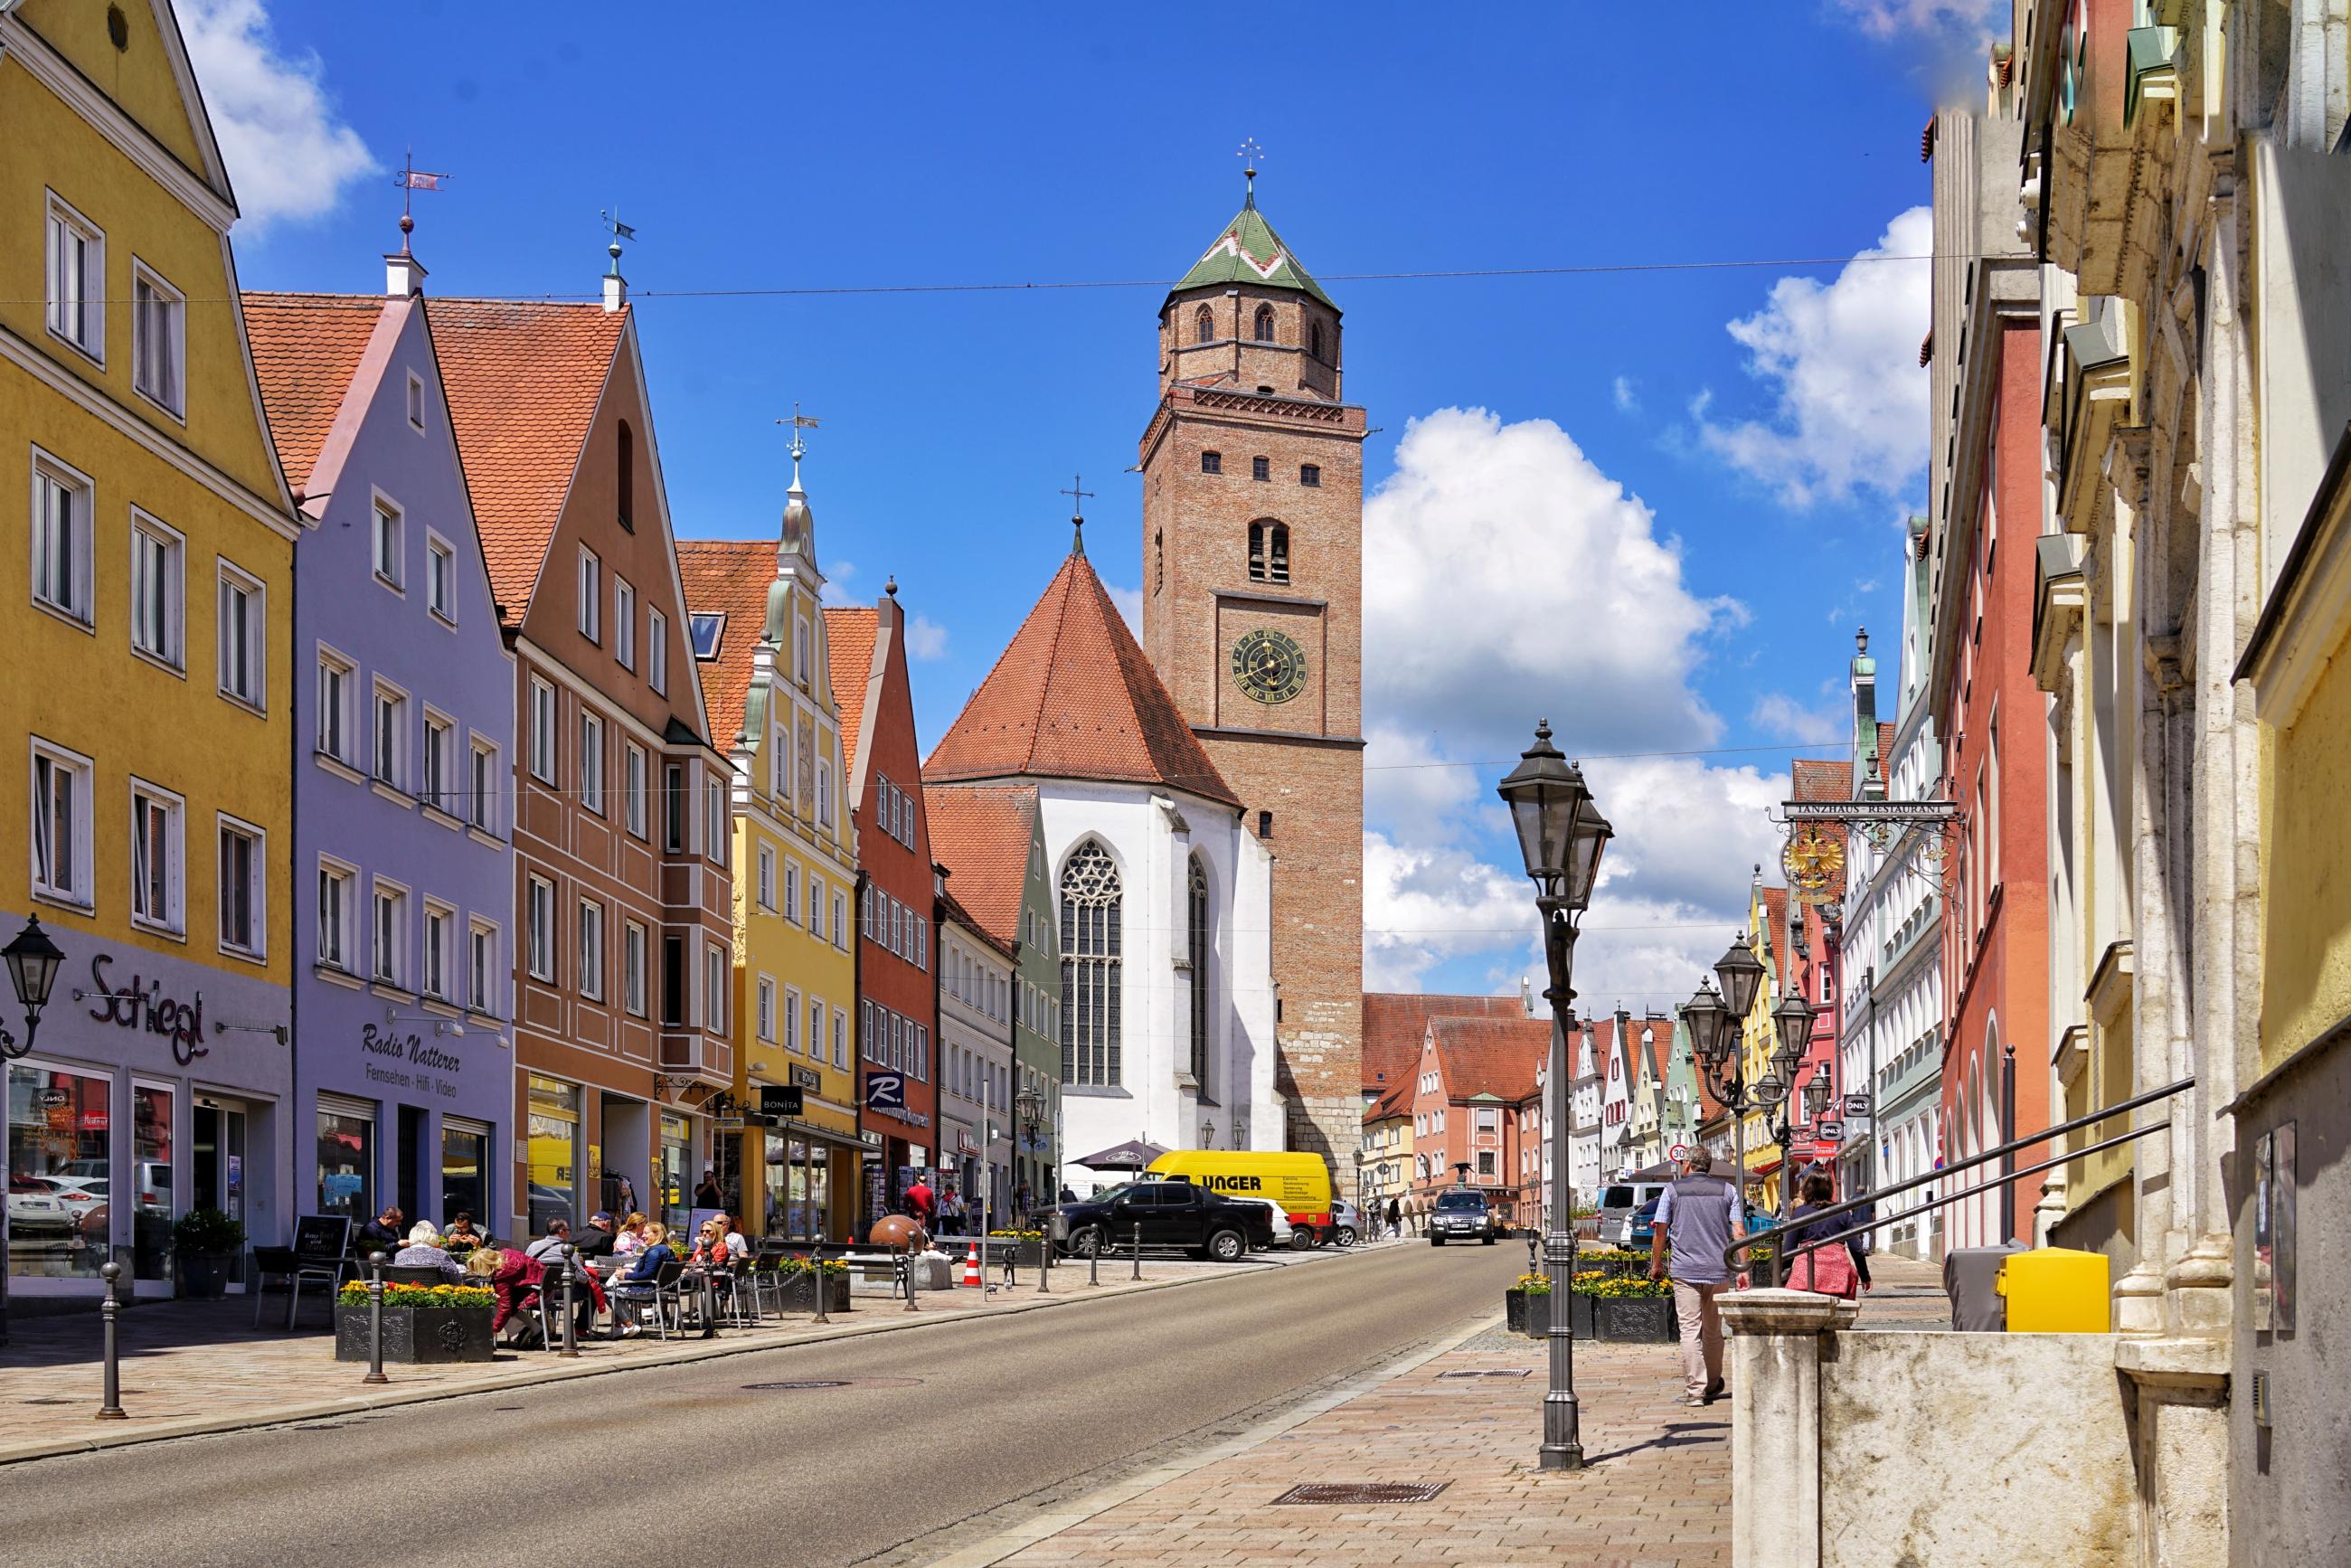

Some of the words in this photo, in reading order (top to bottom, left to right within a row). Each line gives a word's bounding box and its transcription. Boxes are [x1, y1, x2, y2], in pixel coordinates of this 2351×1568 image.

[362, 1023, 403, 1058] Radio
[407, 1034, 460, 1073] Natterer
[365, 1063, 411, 1088] Fernsehen
[416, 1073, 430, 1091] Hifi
[435, 1079, 456, 1098] Video
[1674, 1148, 1685, 1158] 30
[1202, 1176, 1261, 1191] UNGER
